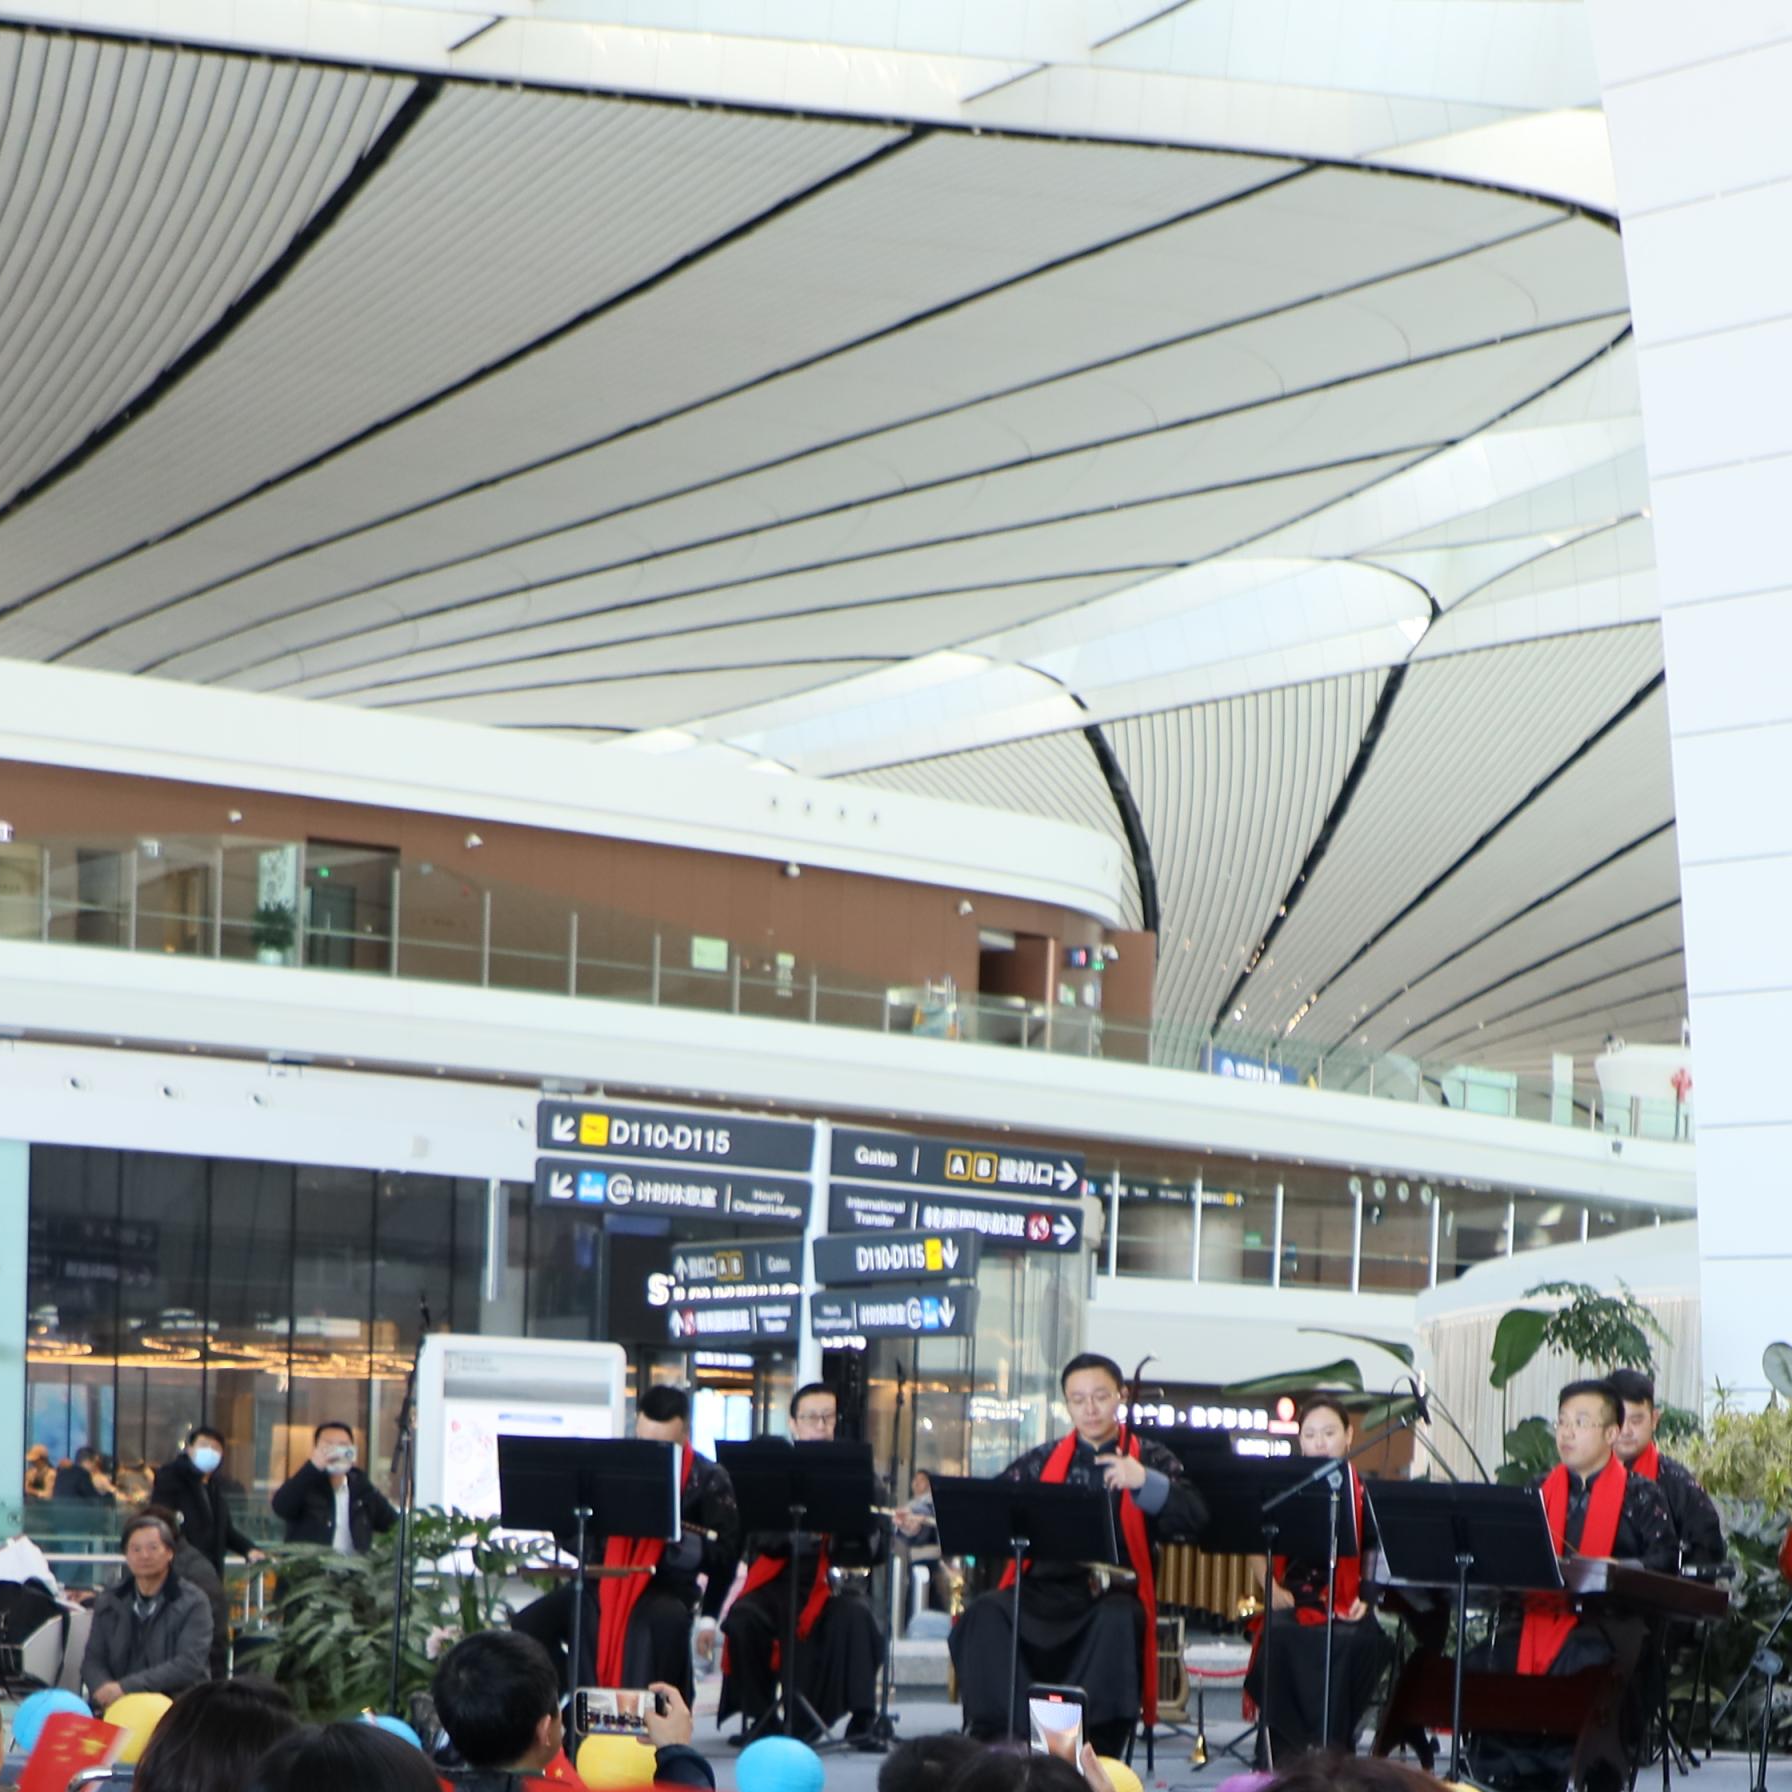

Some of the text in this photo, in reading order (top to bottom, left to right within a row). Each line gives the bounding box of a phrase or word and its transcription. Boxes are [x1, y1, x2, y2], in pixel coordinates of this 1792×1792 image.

[610, 1119, 730, 1154] D110-D115
[854, 1145, 898, 1168] Gates
[951, 1155, 1054, 1186] A B 登机口
[856, 1243, 925, 1272] D110-D115
